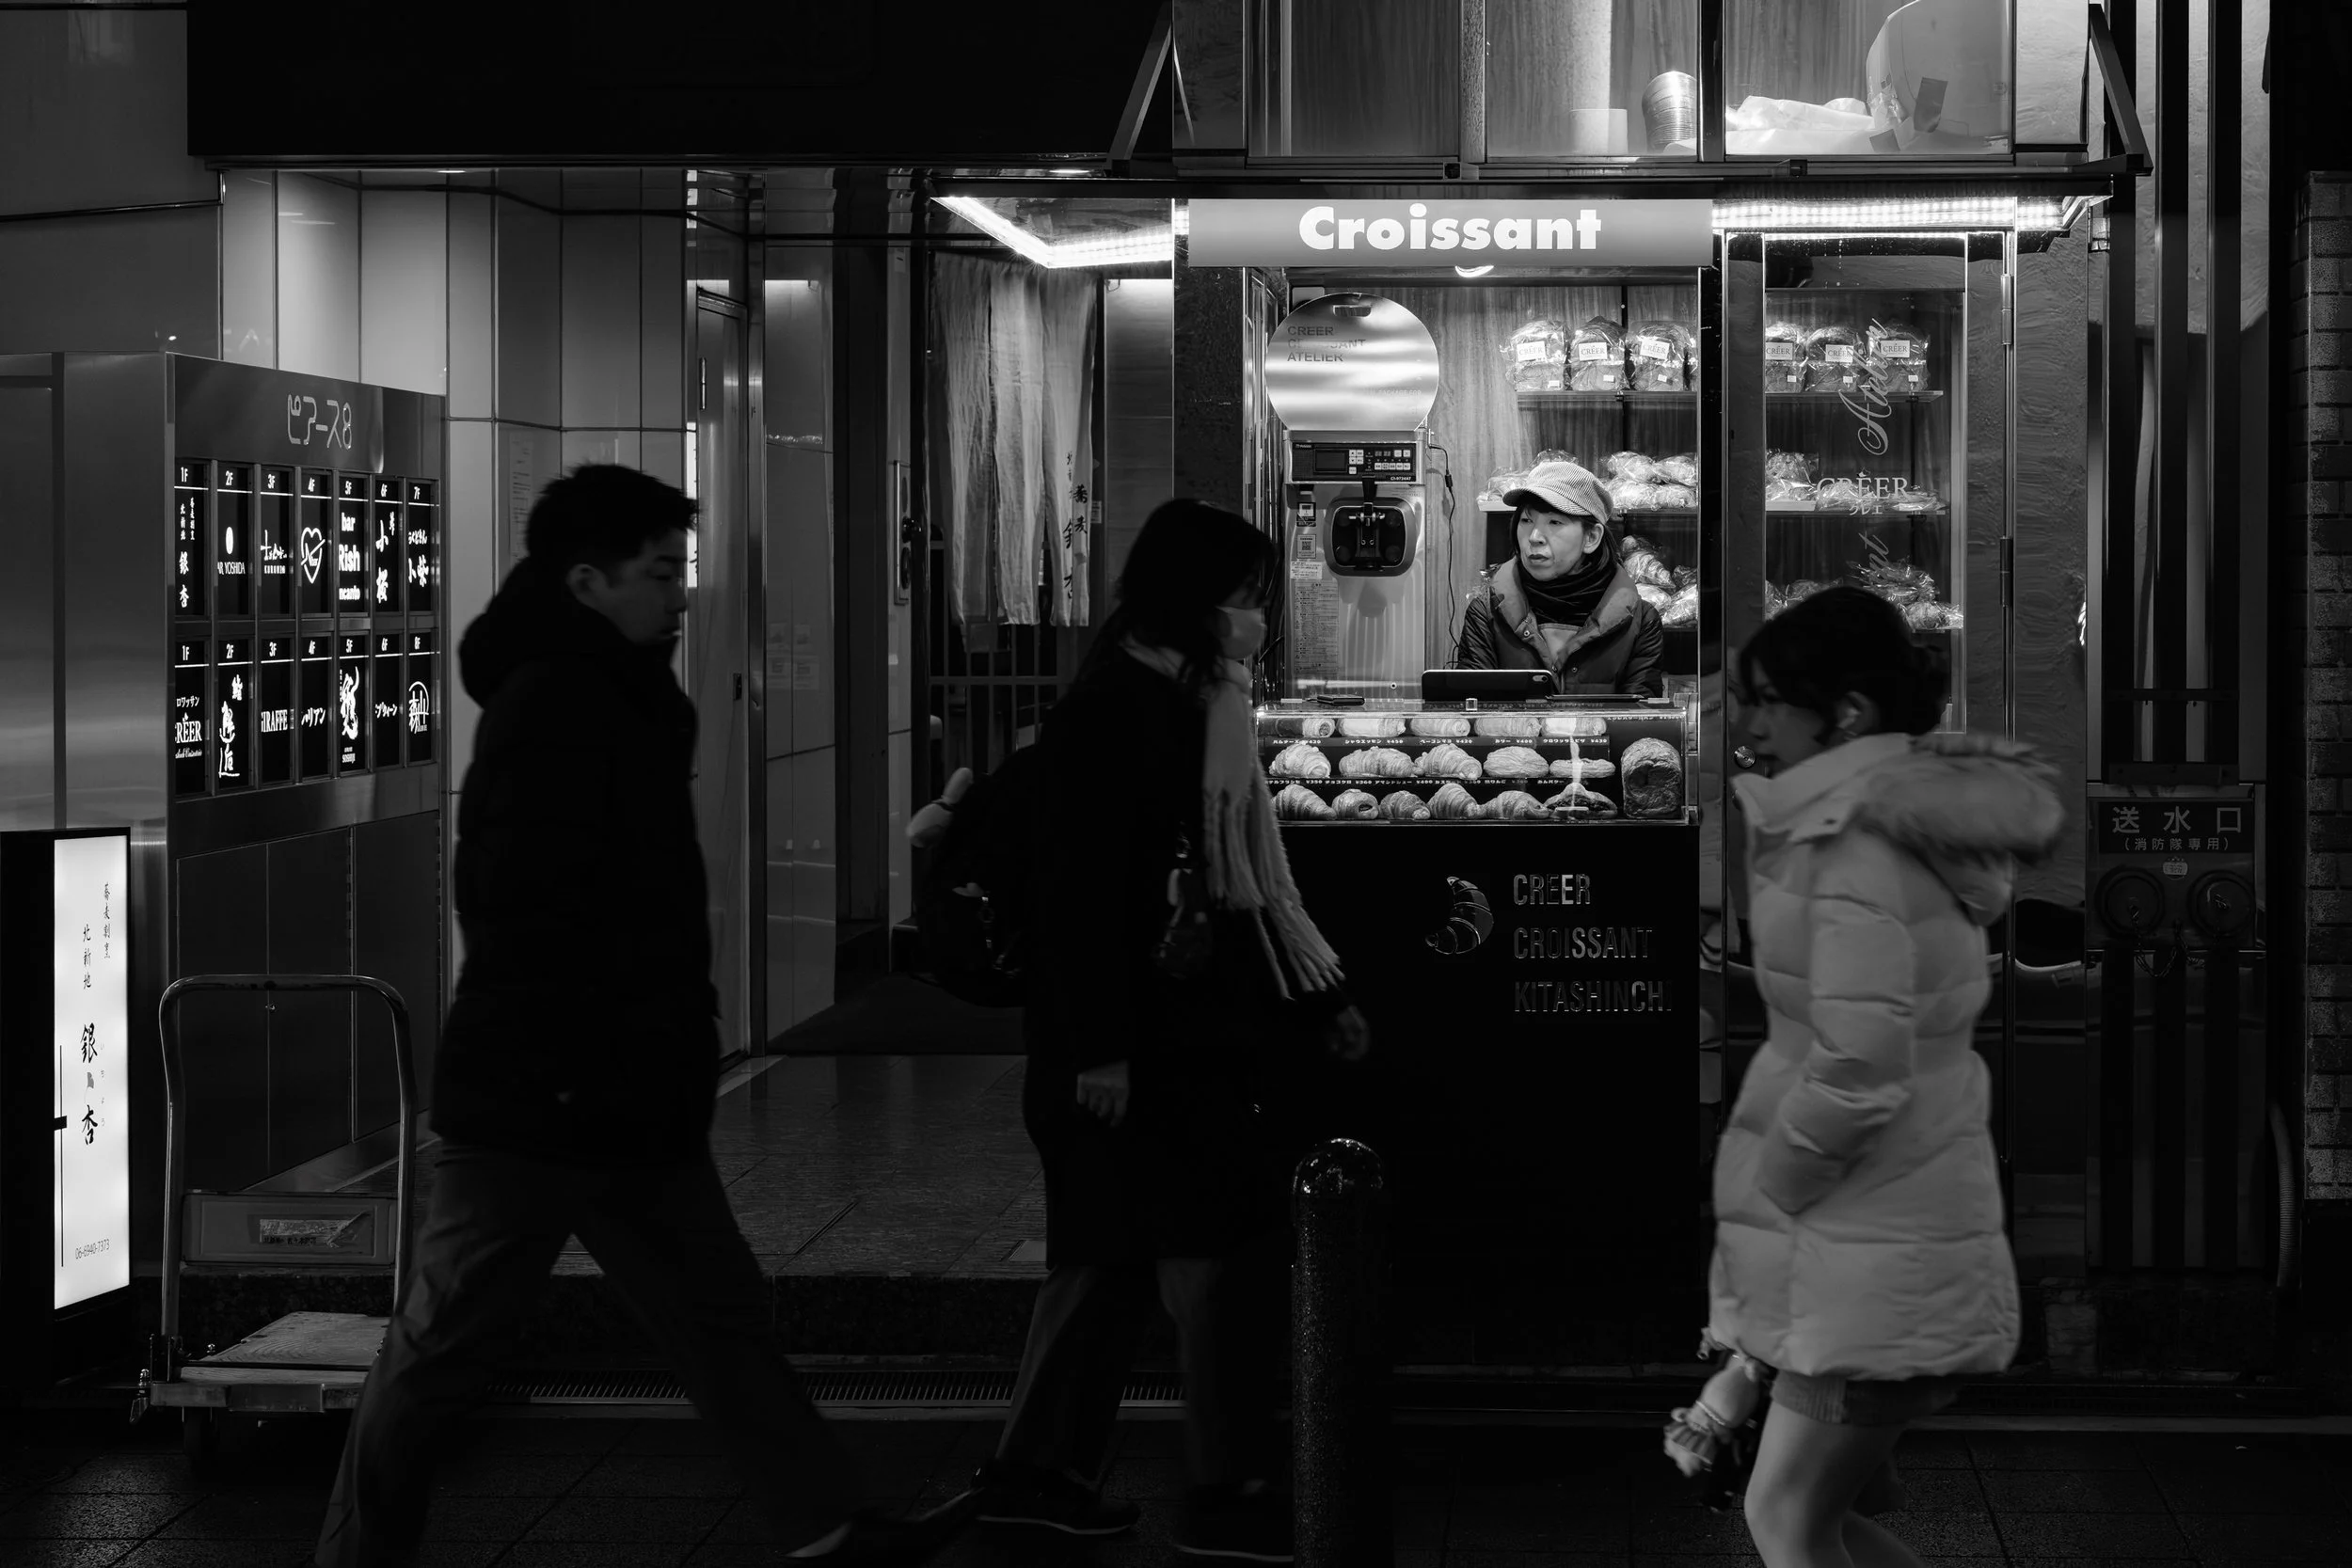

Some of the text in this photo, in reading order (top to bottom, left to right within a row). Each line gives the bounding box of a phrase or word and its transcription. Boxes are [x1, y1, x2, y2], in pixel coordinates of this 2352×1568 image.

[1299, 203, 1601, 249] Croissant
[1287, 325, 1334, 337] CREER
[1287, 352, 1343, 361] ATELIER
[287, 393, 352, 450] ピアース8
[181, 467, 188, 482] 1F
[226, 471, 233, 485] 2F
[268, 474, 275, 488] 3F
[308, 478, 314, 492] 4F
[345, 481, 352, 495] 5F
[381, 483, 387, 497] 6F
[414, 486, 420, 499] 7F
[342, 513, 356, 531] bar
[339, 545, 360, 571] Rish
[225, 562, 245, 574] YOSHIDA
[180, 551, 189, 608] 銀杏
[227, 644, 233, 658] 2F
[270, 642, 277, 657] 3F
[309, 641, 315, 655] 4F
[346, 639, 353, 653] 5F
[382, 638, 388, 651] 6F
[183, 645, 189, 660] 1F
[2112, 805, 2242, 834] 送水口
[1513, 873, 1592, 906] CREER
[1513, 927, 1653, 959] CROISSANT
[80, 1022, 99, 1147] 銀杏
